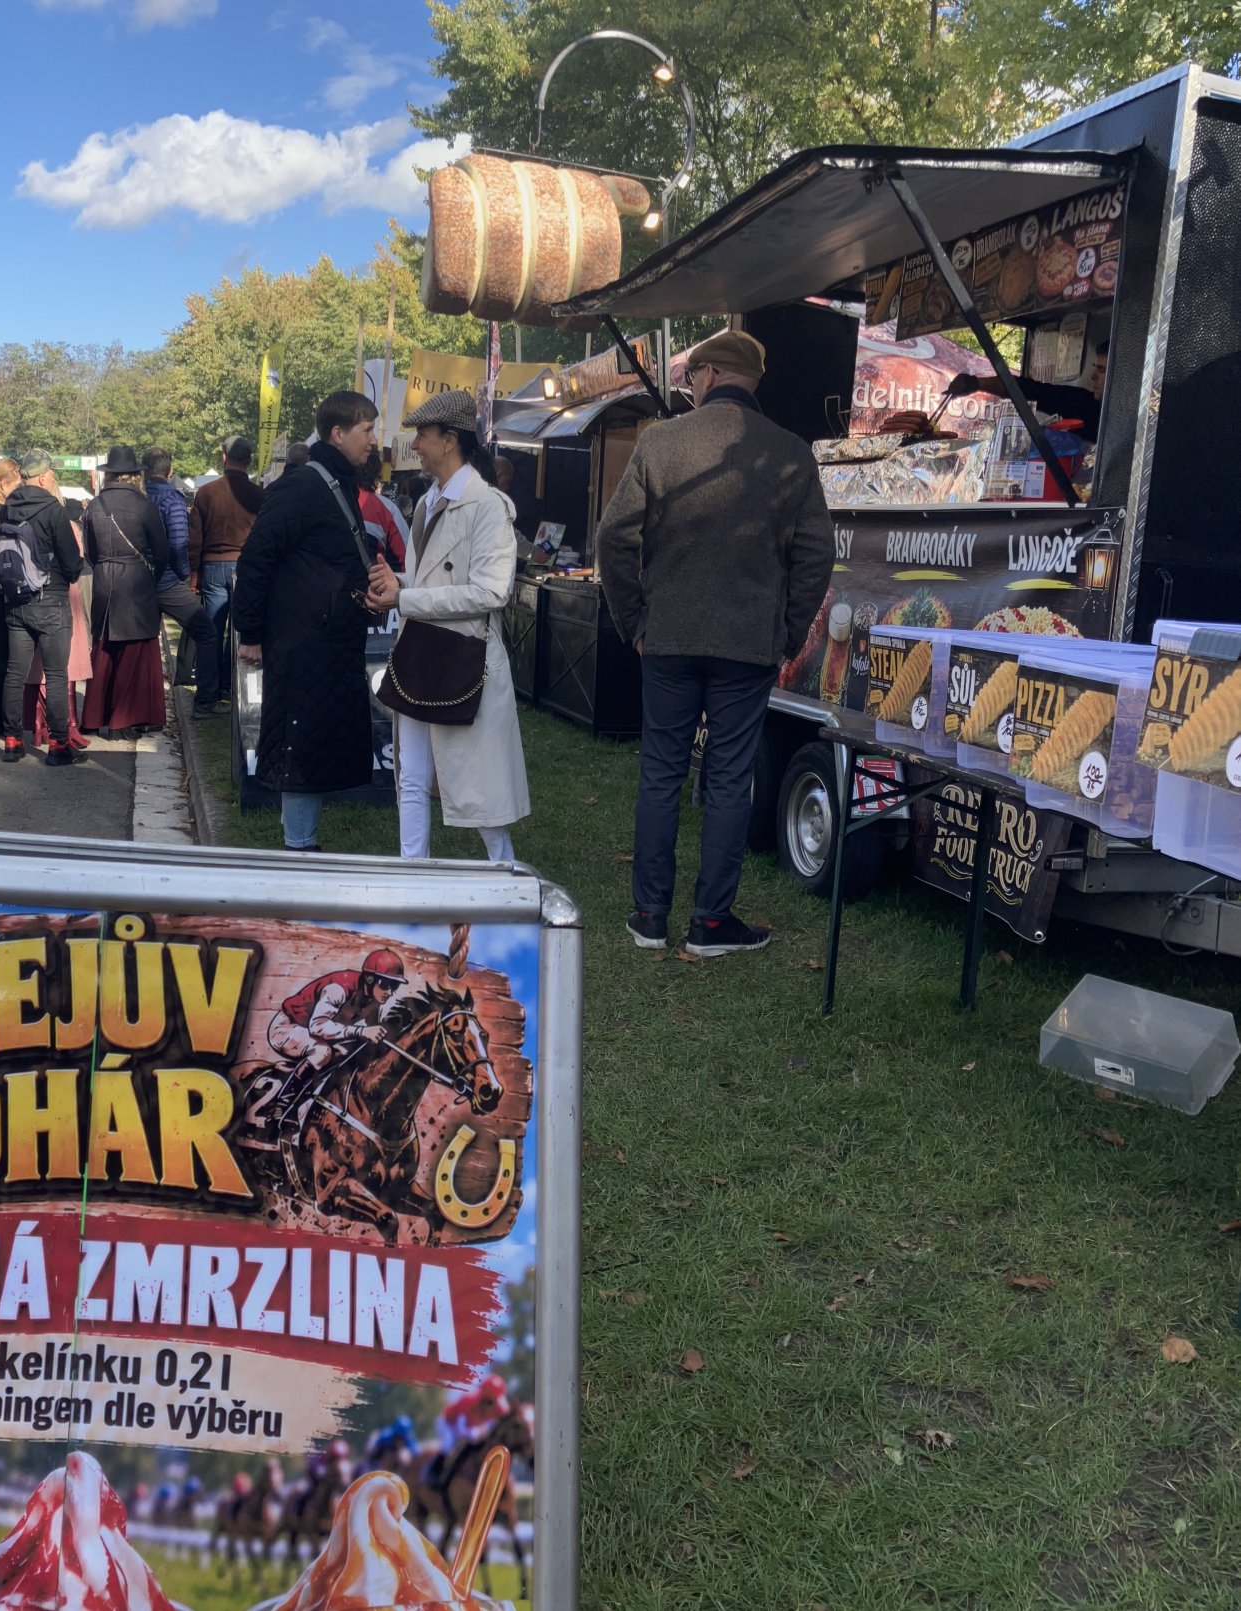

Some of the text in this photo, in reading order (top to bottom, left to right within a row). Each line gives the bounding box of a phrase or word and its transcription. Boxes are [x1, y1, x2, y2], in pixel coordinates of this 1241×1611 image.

[1051, 186, 1125, 235] LANGOŠ
[1087, 222, 1110, 235] slano
[976, 221, 1017, 260] BRAMBORÁK
[904, 262, 934, 283] KLOBÁSA
[886, 525, 977, 568] BRAMBORÁKY
[1008, 528, 1084, 574] LANGOŠE
[949, 662, 977, 707] SŮL
[1016, 677, 1065, 726] PIZZA
[1149, 655, 1210, 716] SÝR
[942, 784, 1037, 858] RERO
[988, 847, 1036, 894] TRUCK
[246, 1076, 283, 1128] 2
[77, 1240, 460, 1366] ZMRZLINA
[155, 1348, 211, 1394] 0,2
[220, 1354, 232, 1391] l
[104, 1391, 155, 1429] dle
[167, 1398, 283, 1440] výběru
